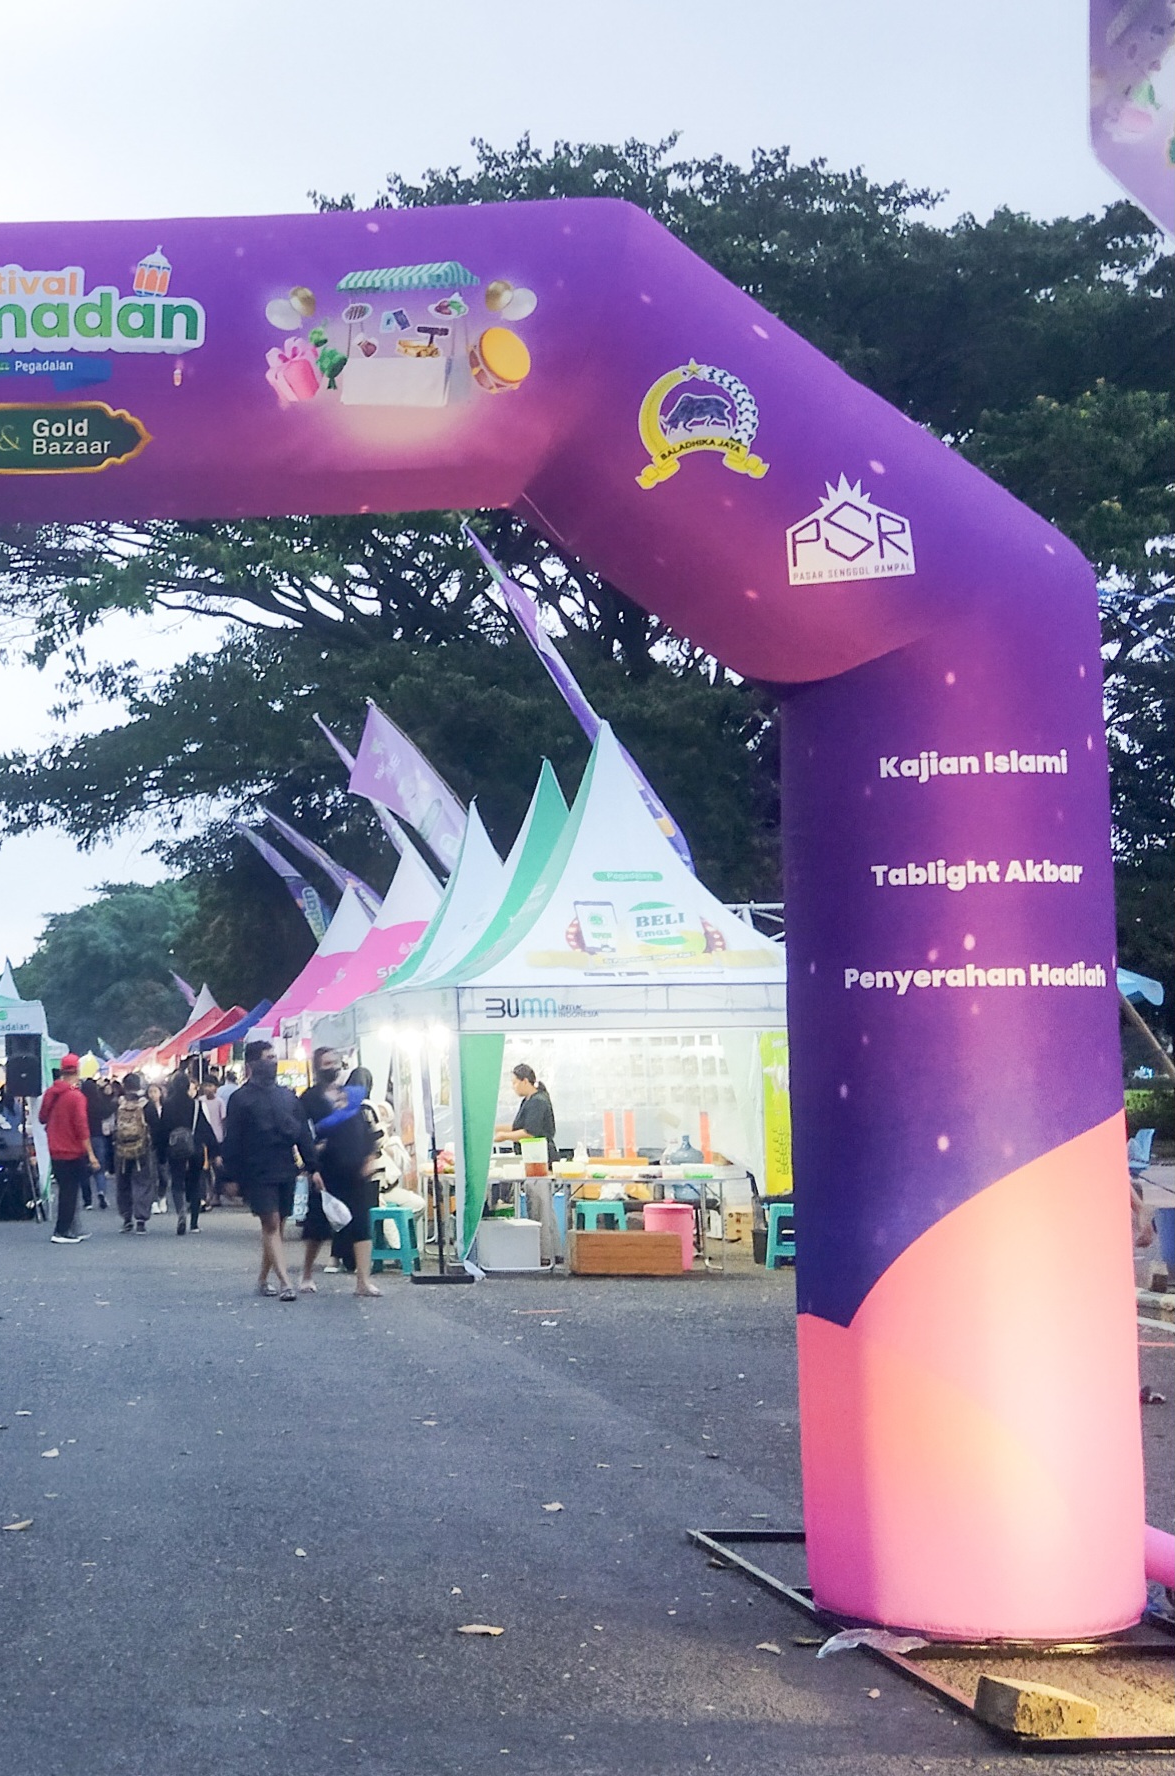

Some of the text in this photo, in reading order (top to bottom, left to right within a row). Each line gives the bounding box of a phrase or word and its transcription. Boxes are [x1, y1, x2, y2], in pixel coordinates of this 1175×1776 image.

[15, 359, 74, 374] Pegadaian
[32, 418, 88, 437] Gold
[32, 438, 111, 455] Bazaar
[660, 439, 741, 461] BALADHIKA JAYA
[791, 501, 909, 567] PSR
[793, 571, 823, 581] PASAR
[874, 562, 912, 574] RAMPAL
[879, 749, 1068, 783] Kajian Islami
[871, 859, 1083, 891] Tablight Akbar
[636, 912, 684, 927] BELI
[636, 929, 671, 938] Emas
[844, 961, 1107, 995] Penyerahan Hadiah
[485, 998, 557, 1018] BUMN
